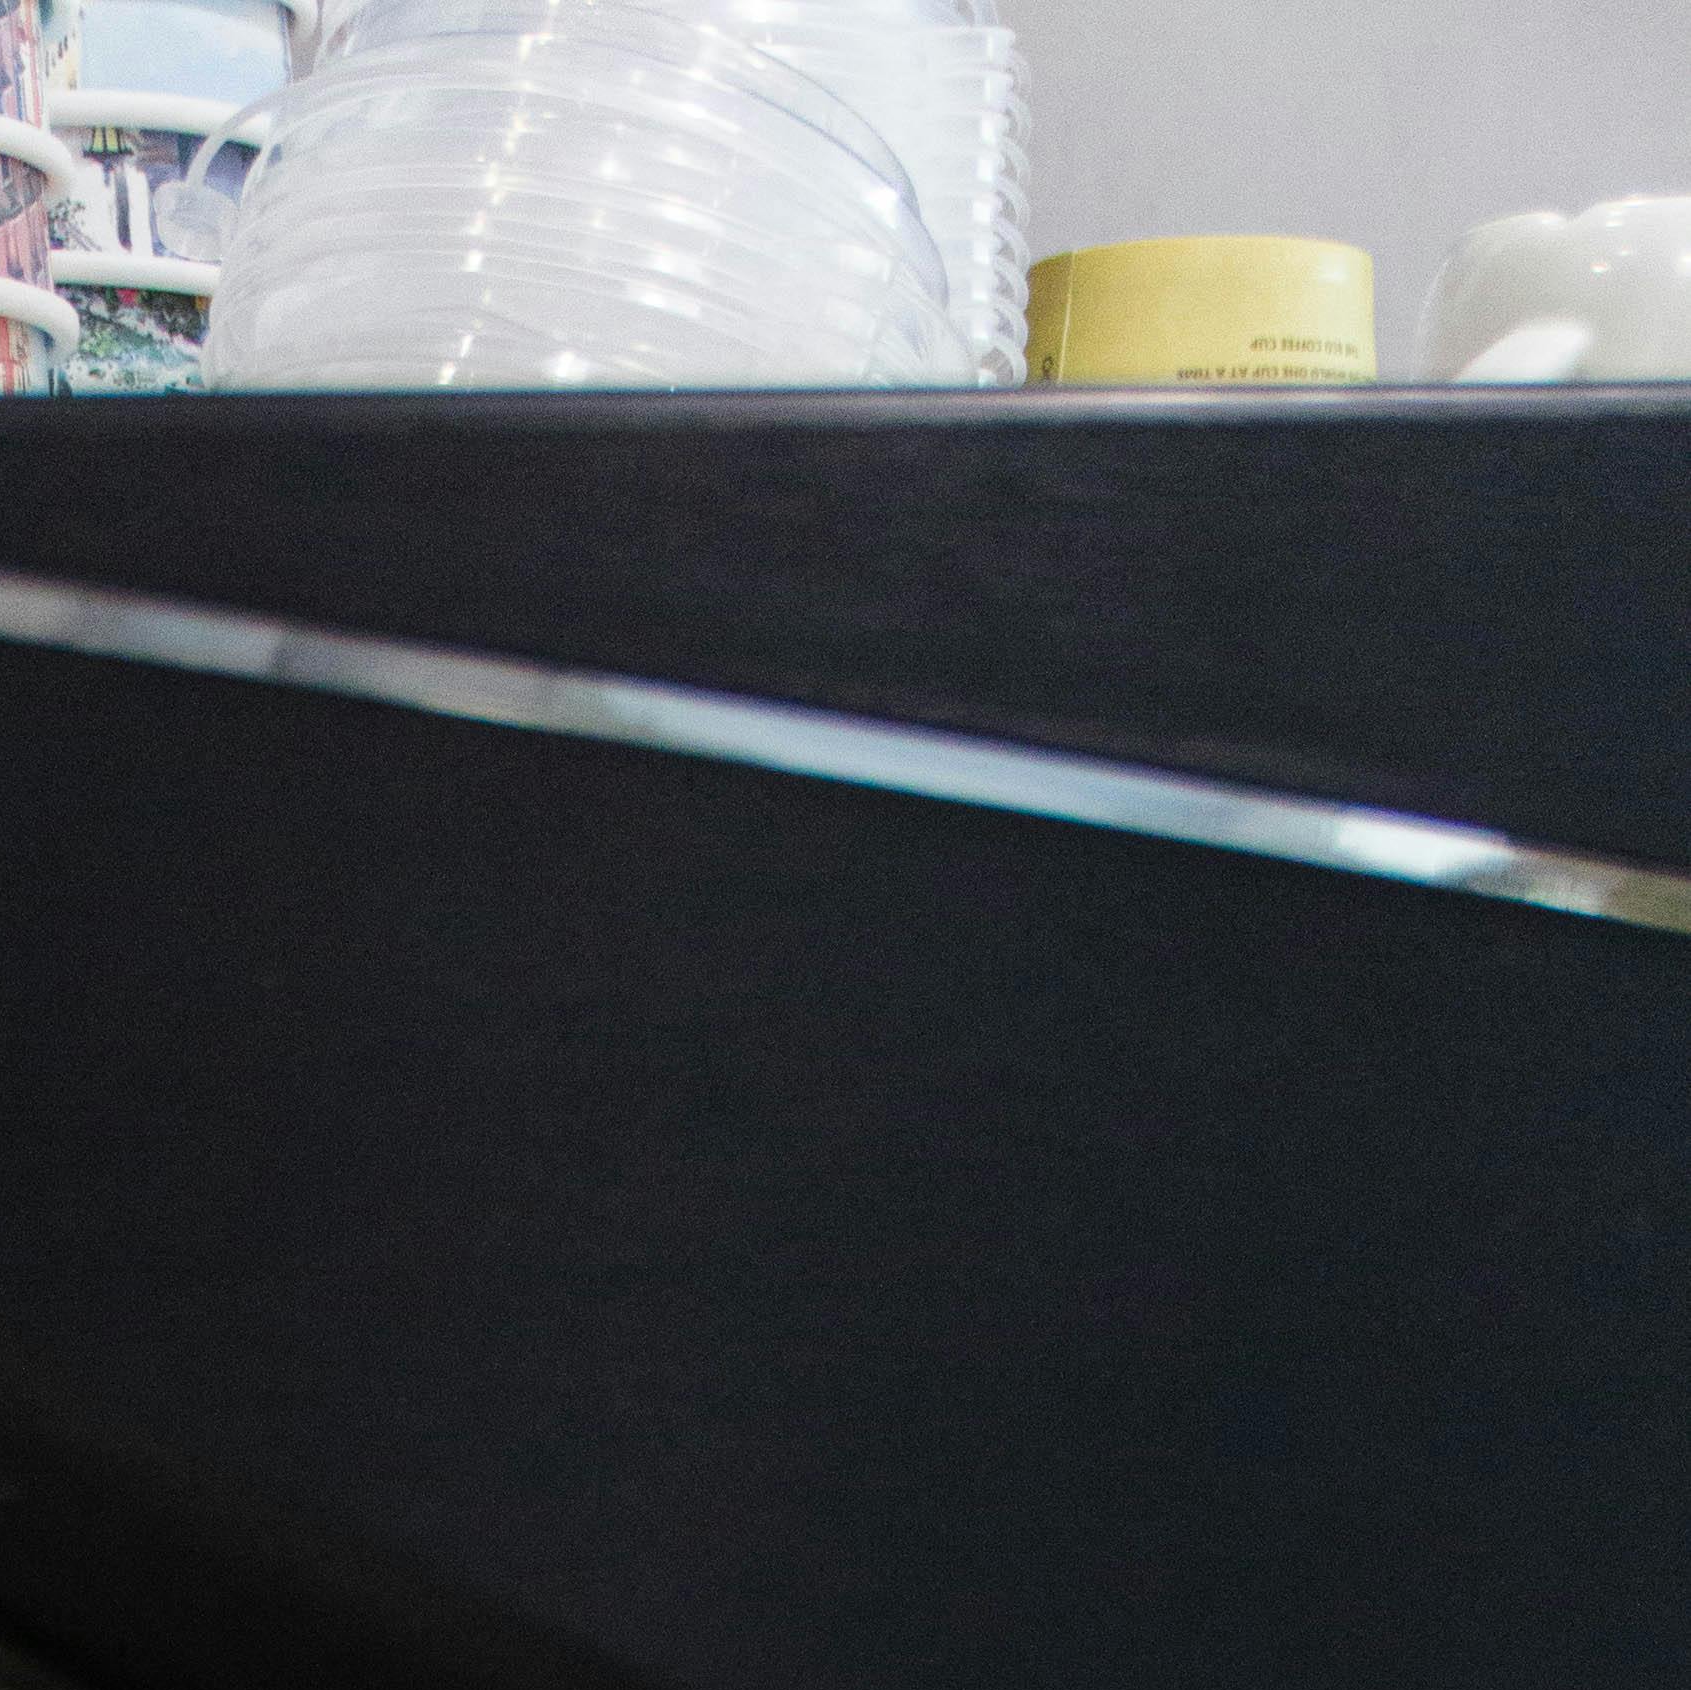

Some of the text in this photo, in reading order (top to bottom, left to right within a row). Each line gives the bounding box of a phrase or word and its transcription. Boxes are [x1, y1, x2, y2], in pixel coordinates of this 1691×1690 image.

[1249, 337, 1278, 352] CUP
[1281, 338, 1323, 354] COFFEE
[1177, 368, 1211, 381] TIME
[1215, 367, 1226, 379] A
[1230, 367, 1248, 379] AT
[1252, 366, 1279, 379] CUP
[1282, 366, 1308, 379] ONE
